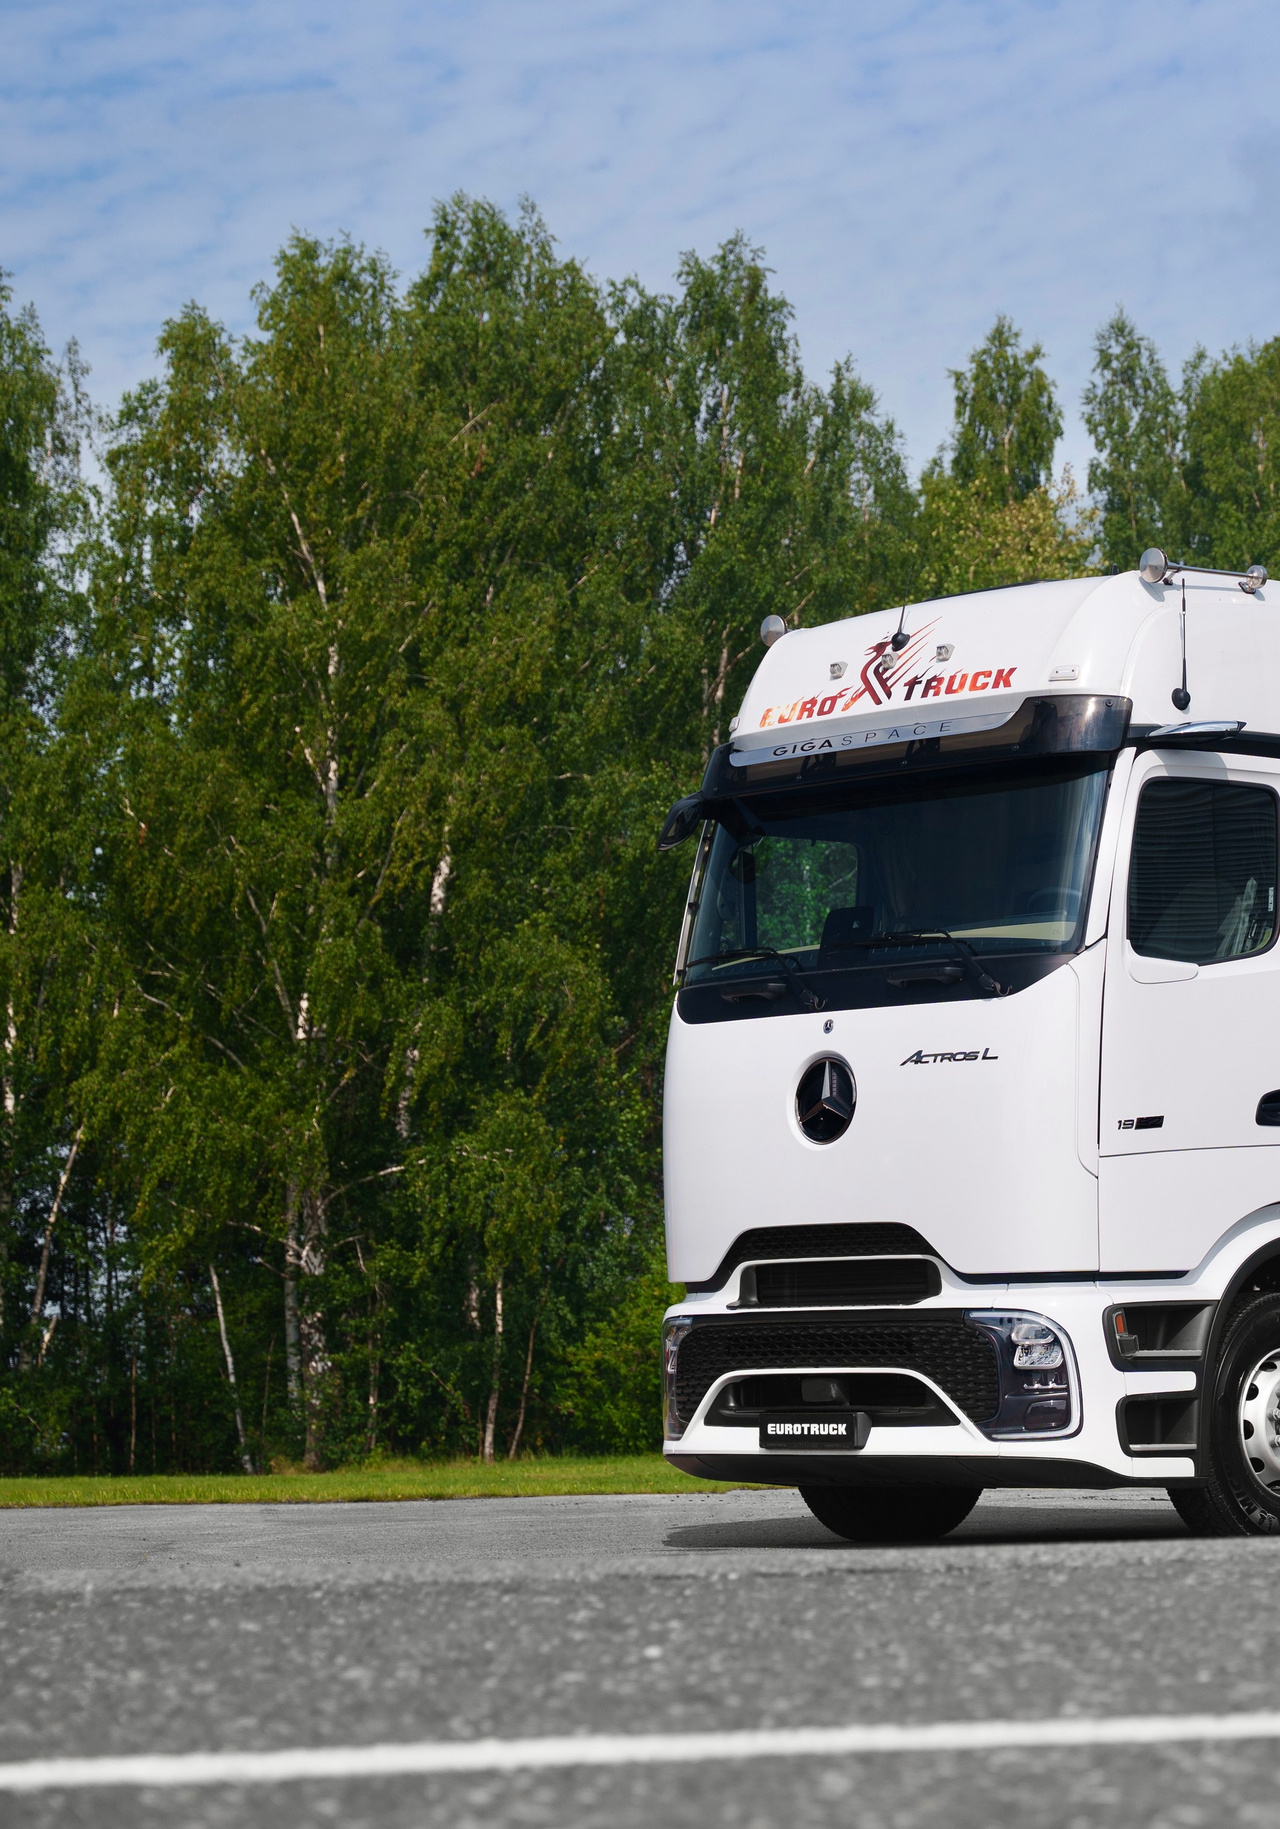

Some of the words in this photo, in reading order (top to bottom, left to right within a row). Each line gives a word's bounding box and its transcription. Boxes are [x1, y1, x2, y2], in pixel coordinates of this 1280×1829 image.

[759, 693, 839, 728] EURO
[903, 667, 1018, 701] TRUCK
[981, 1047, 998, 1060] L
[767, 1423, 848, 1435] EUROTRUCK
